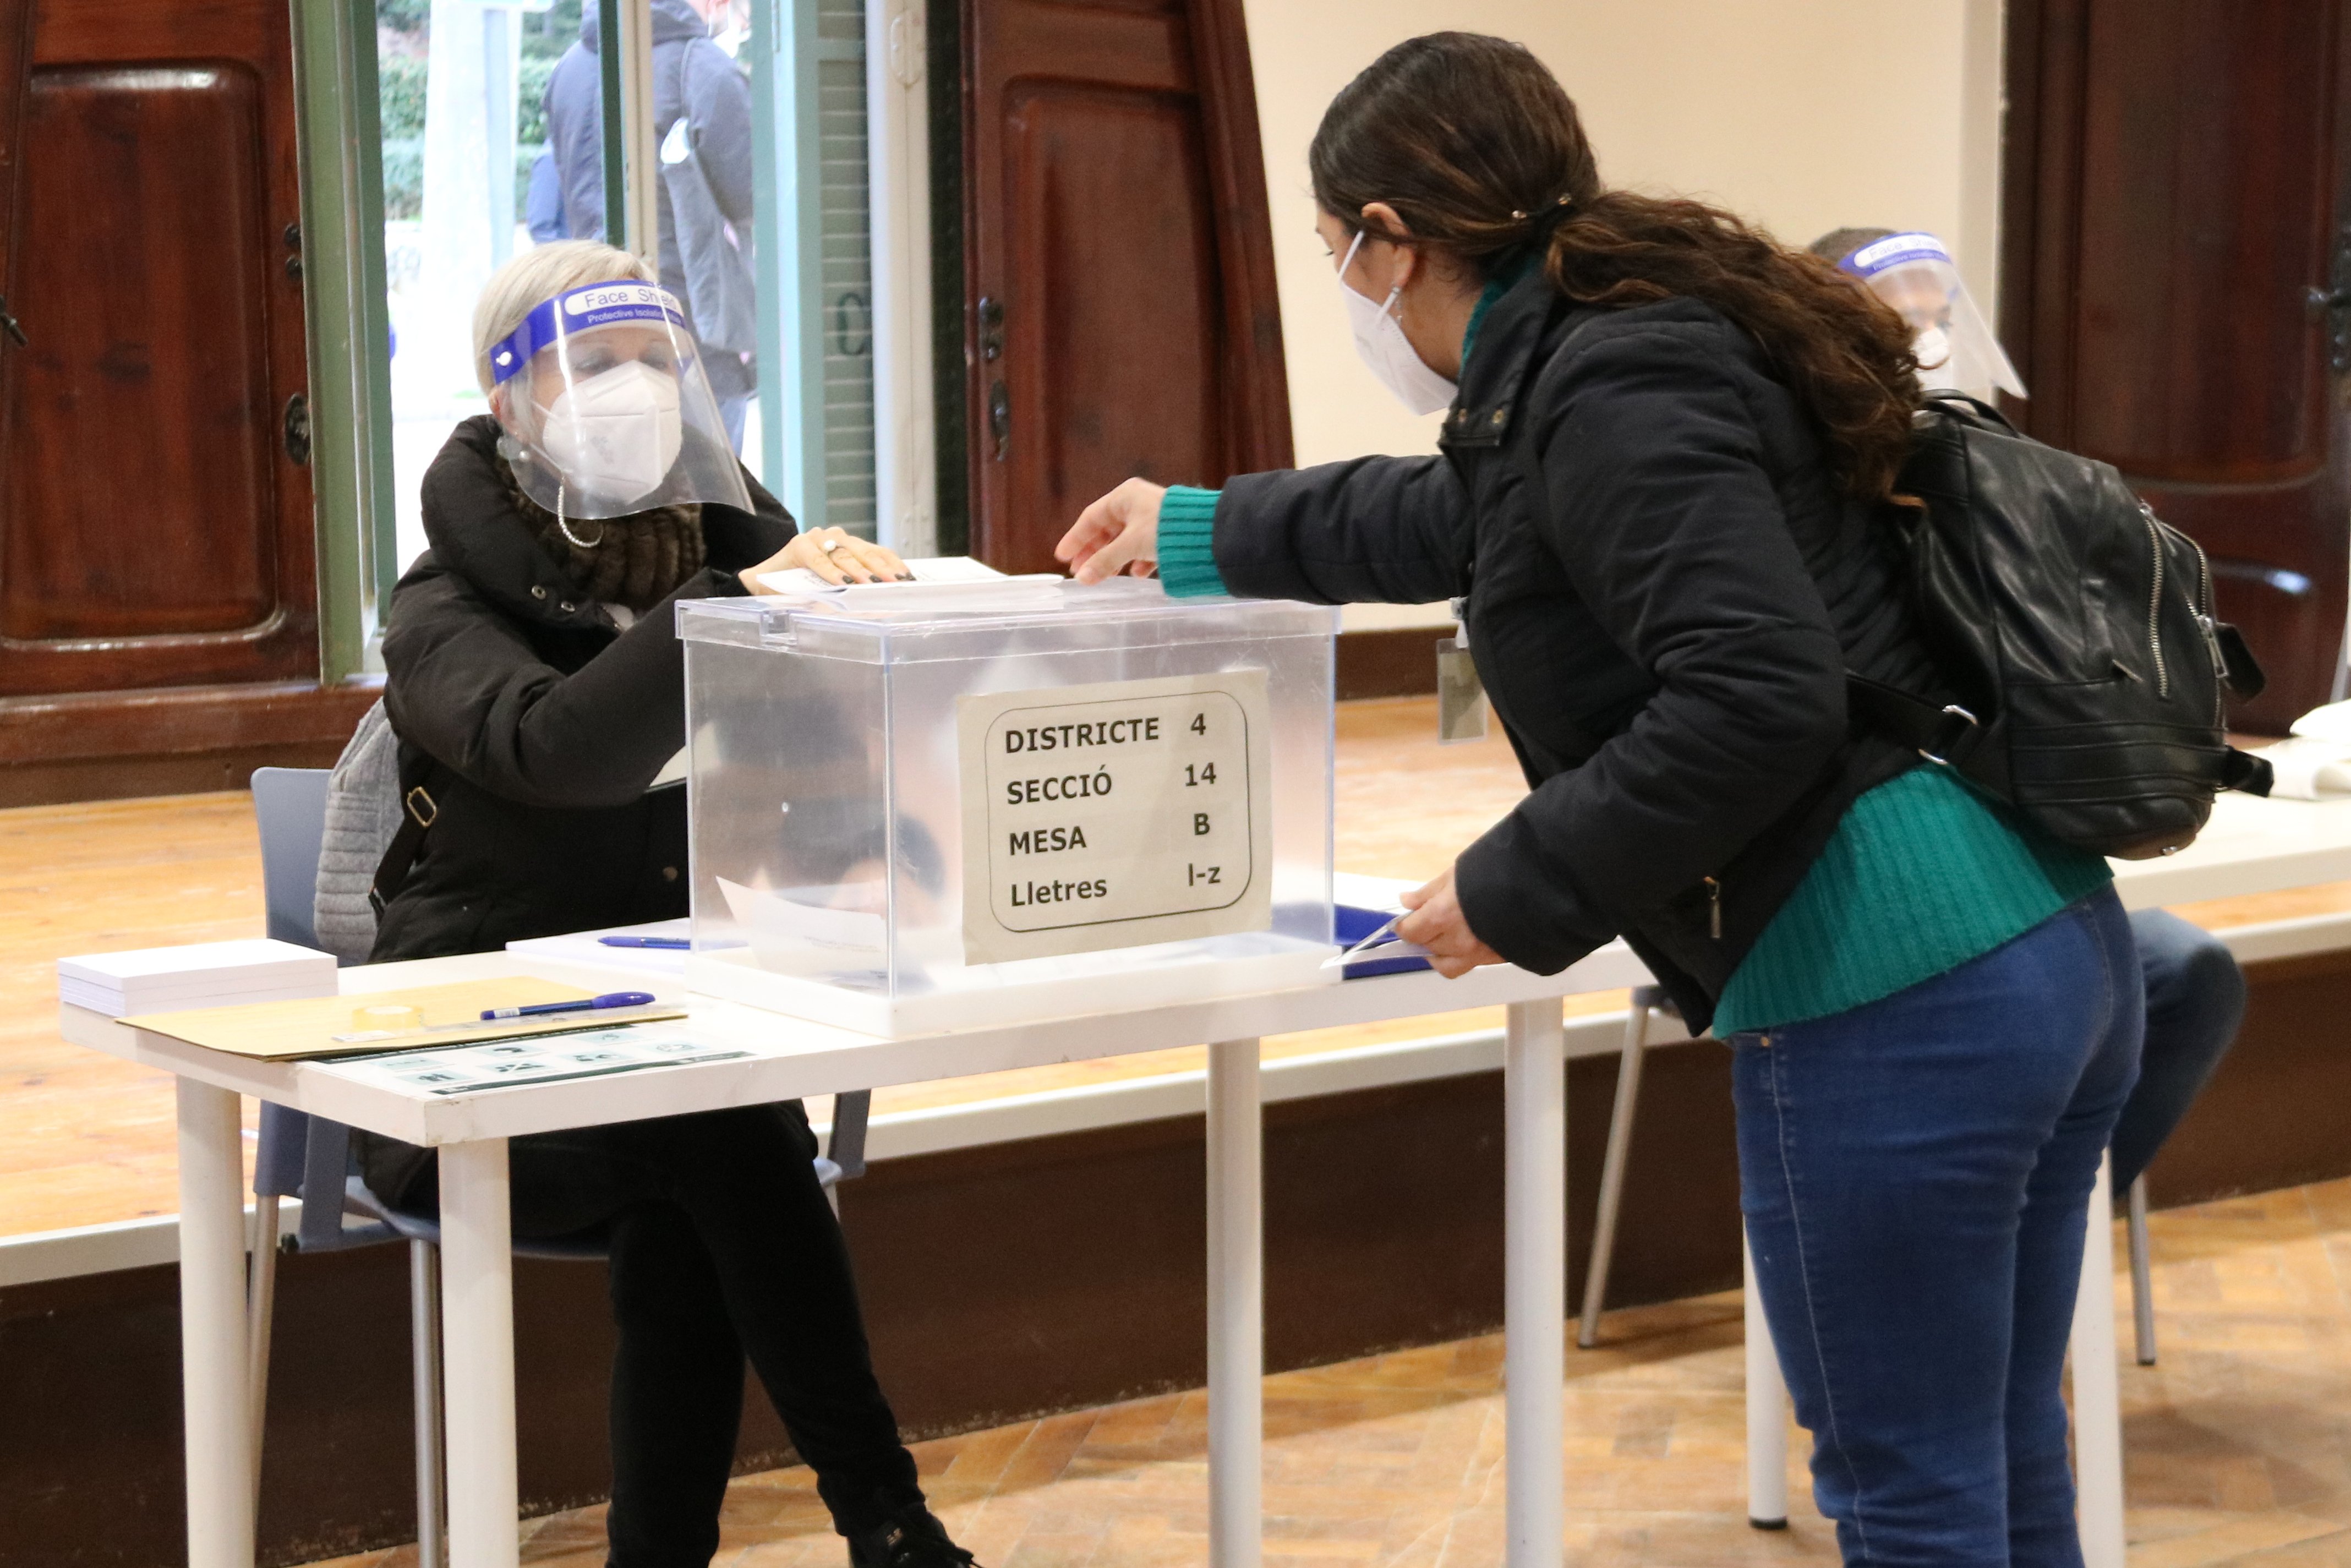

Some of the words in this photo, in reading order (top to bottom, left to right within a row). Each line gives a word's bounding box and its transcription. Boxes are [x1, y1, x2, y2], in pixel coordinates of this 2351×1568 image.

[584, 291, 628, 308] Face
[637, 288, 677, 310] Sheld
[587, 309, 633, 324] Protective
[1005, 717, 1160, 754] DISTRICTE
[1190, 713, 1207, 736] 4
[1007, 764, 1112, 805] SECCIÓ
[1185, 762, 1217, 787] 14
[1009, 826, 1087, 856] MESA
[1194, 812, 1211, 836] B
[1011, 879, 1108, 907] Lletres
